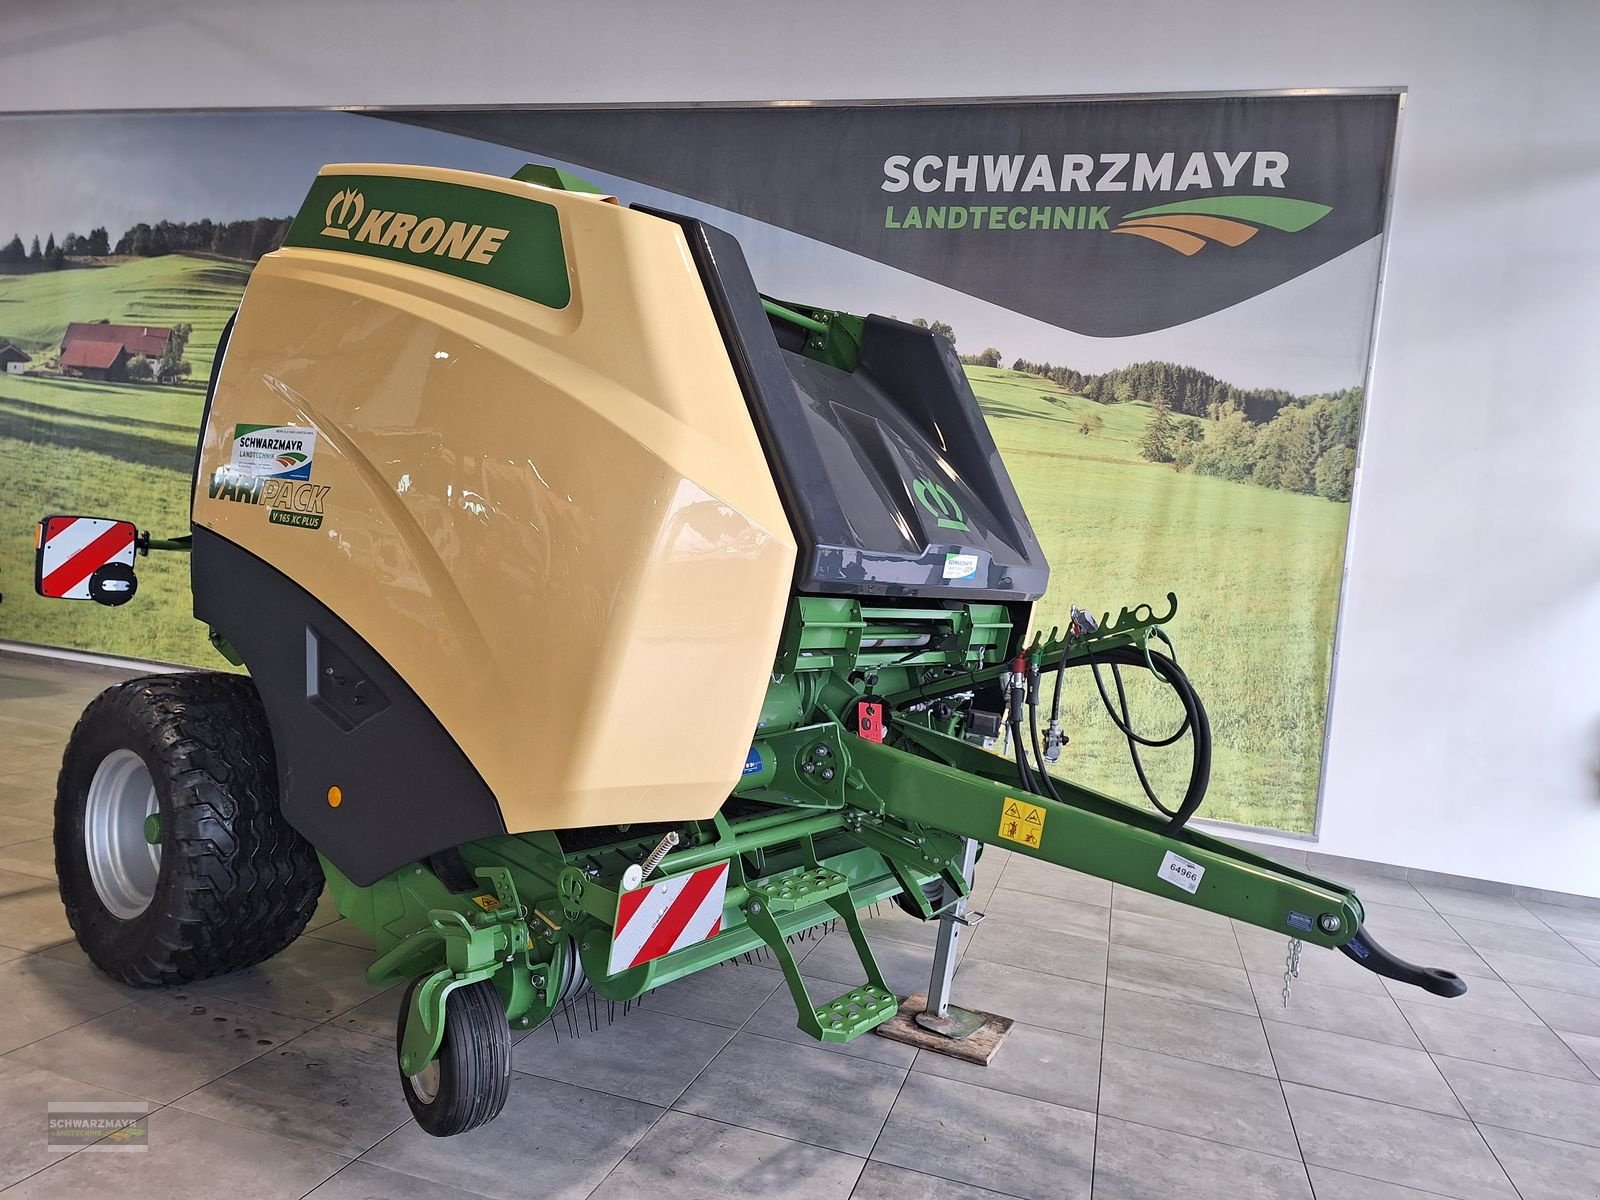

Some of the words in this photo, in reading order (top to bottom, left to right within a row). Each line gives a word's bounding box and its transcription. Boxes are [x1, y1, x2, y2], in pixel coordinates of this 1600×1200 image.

[880, 150, 1290, 193] SCHWARZMAYR
[884, 205, 1111, 230] LANDTECHNIK
[354, 209, 510, 265] KRONE
[239, 436, 303, 451] SCHWARZMAYR
[239, 450, 275, 460] LANDTECHNIK
[272, 512, 278, 521] V
[279, 513, 291, 523] 165
[291, 514, 302, 525] XC
[301, 516, 320, 527] PLUS
[1170, 863, 1197, 881] 64966
